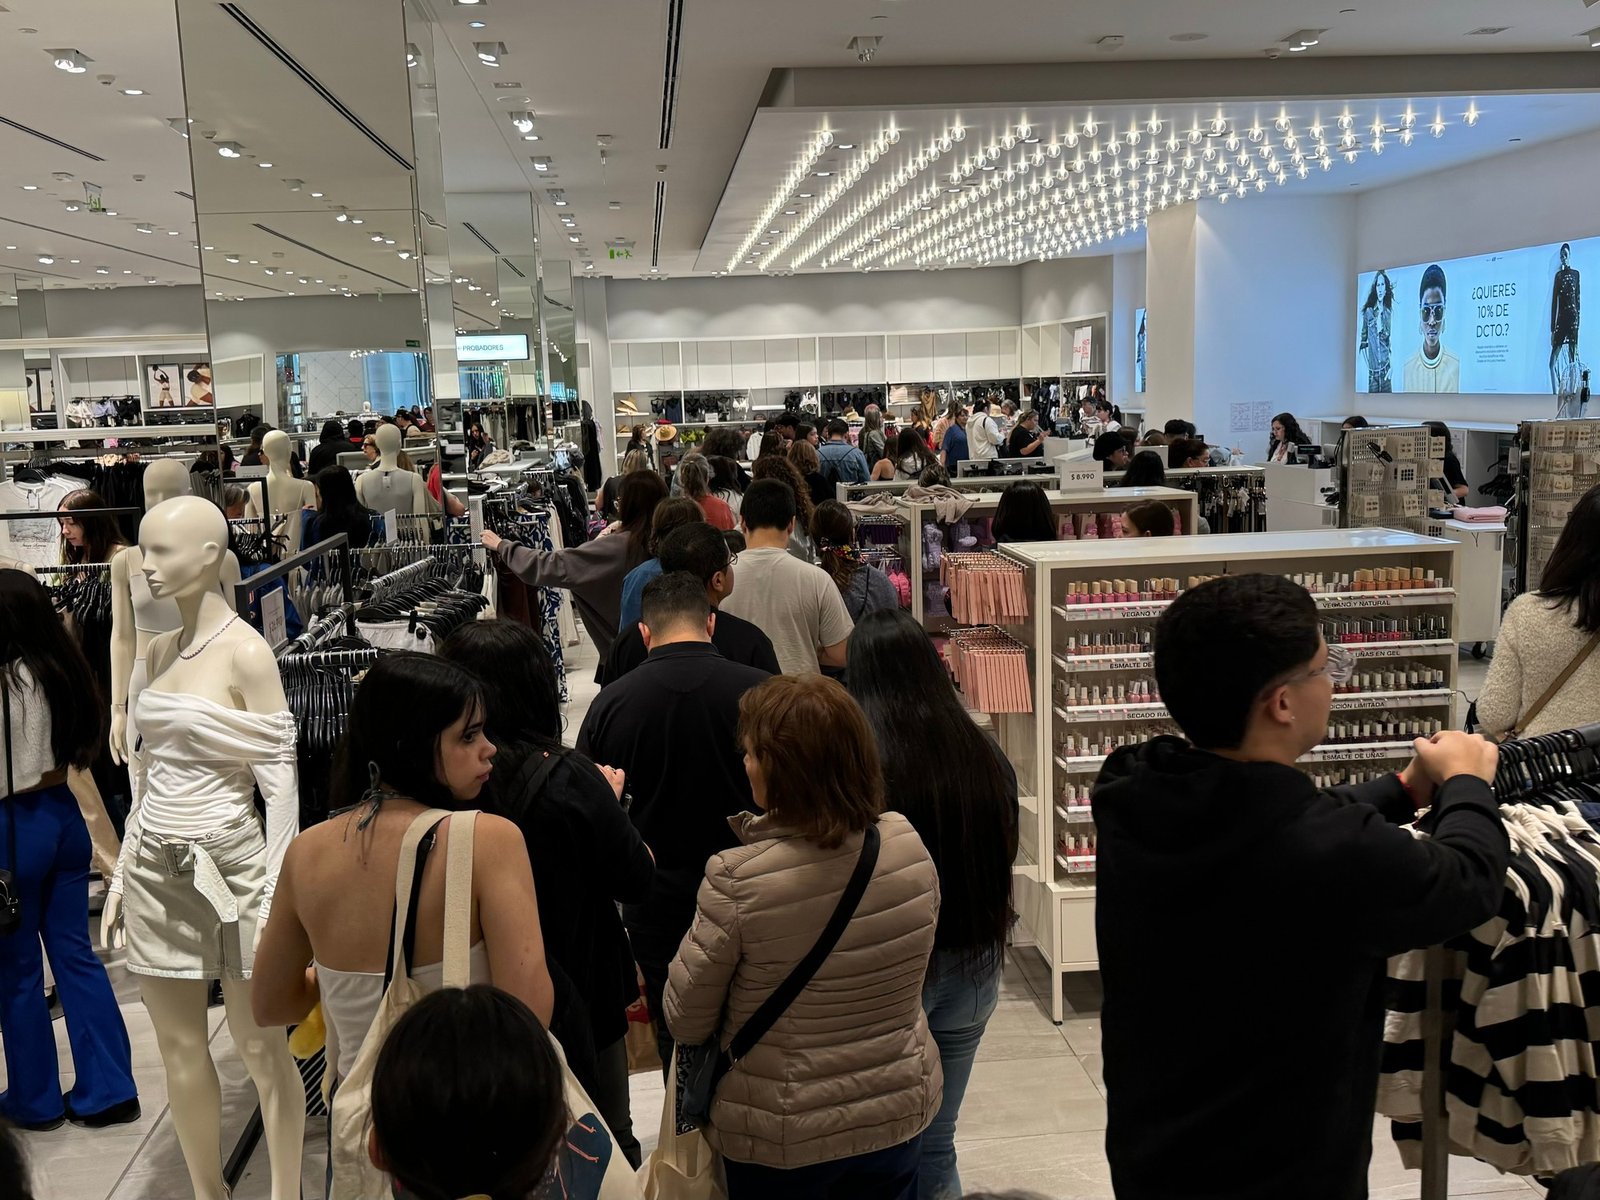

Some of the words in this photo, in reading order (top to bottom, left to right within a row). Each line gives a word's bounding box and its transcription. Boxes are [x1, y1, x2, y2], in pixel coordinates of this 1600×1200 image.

[1471, 283, 1516, 300] ¿QUIERES
[1477, 304, 1494, 318] 10%
[1495, 304, 1509, 317] DE
[1476, 323, 1510, 338] DCTO.?
[462, 344, 504, 352] PROBADORES
[1358, 599, 1391, 607] NATURAL
[1121, 610, 1151, 618] VEGANO
[1355, 650, 1375, 658] UÑAS
[1354, 701, 1385, 709] LIMITADA
[1322, 753, 1353, 761] ESMALTE
